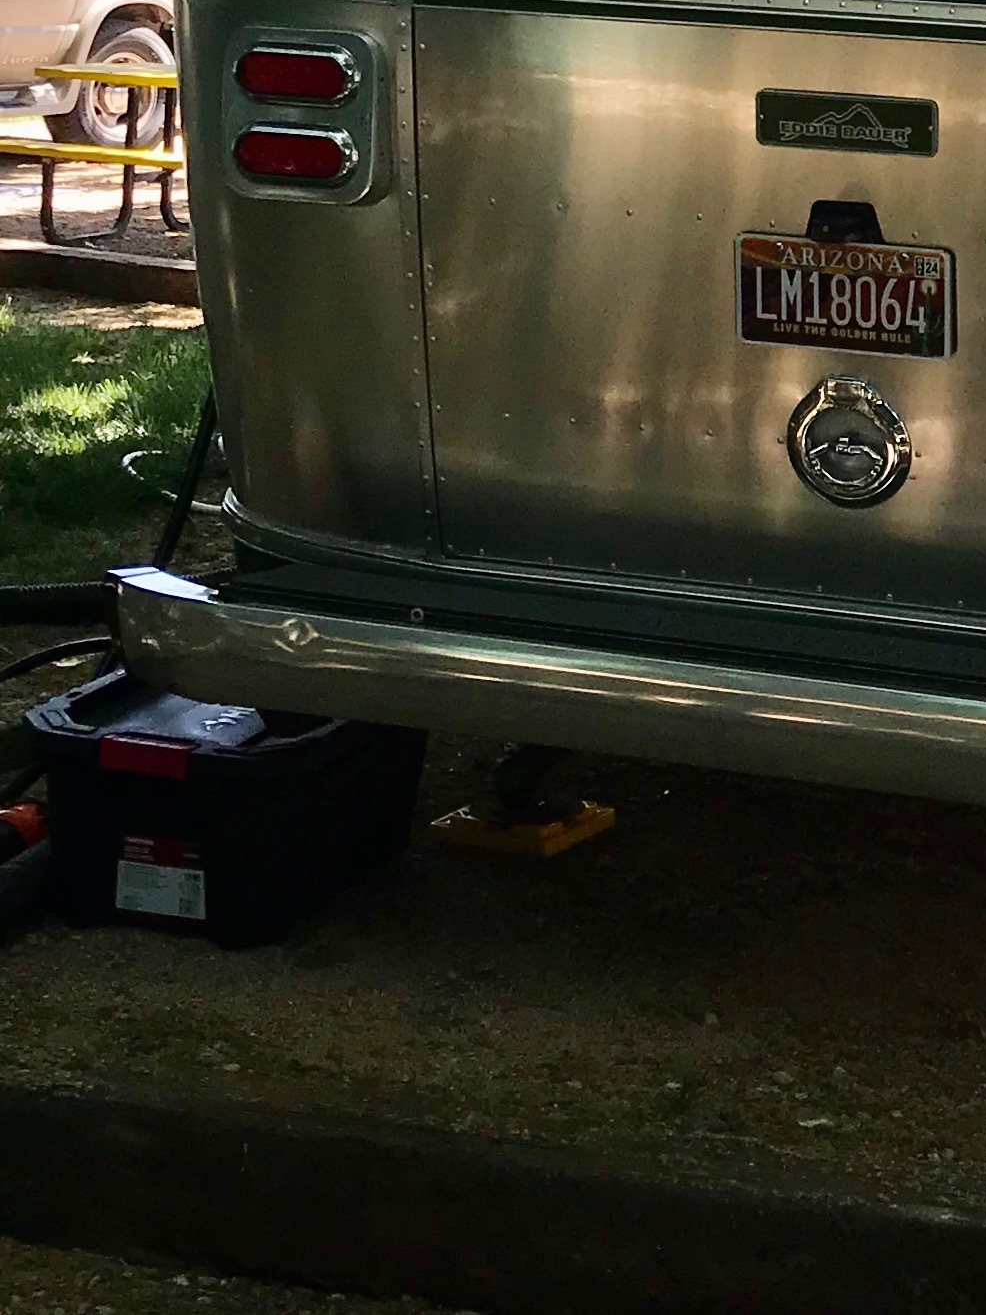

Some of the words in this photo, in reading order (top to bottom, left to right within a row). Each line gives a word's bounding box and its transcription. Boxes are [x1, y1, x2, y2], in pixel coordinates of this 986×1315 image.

[779, 120, 837, 138] EDDIE
[841, 125, 908, 142] BAUER
[780, 246, 904, 273] ARIZONA
[925, 261, 938, 274] 24
[756, 266, 926, 333] LM18064
[773, 322, 799, 334] LIVE
[804, 325, 827, 336] THE
[831, 327, 877, 341] GOLDEN
[881, 332, 911, 344] RULE
